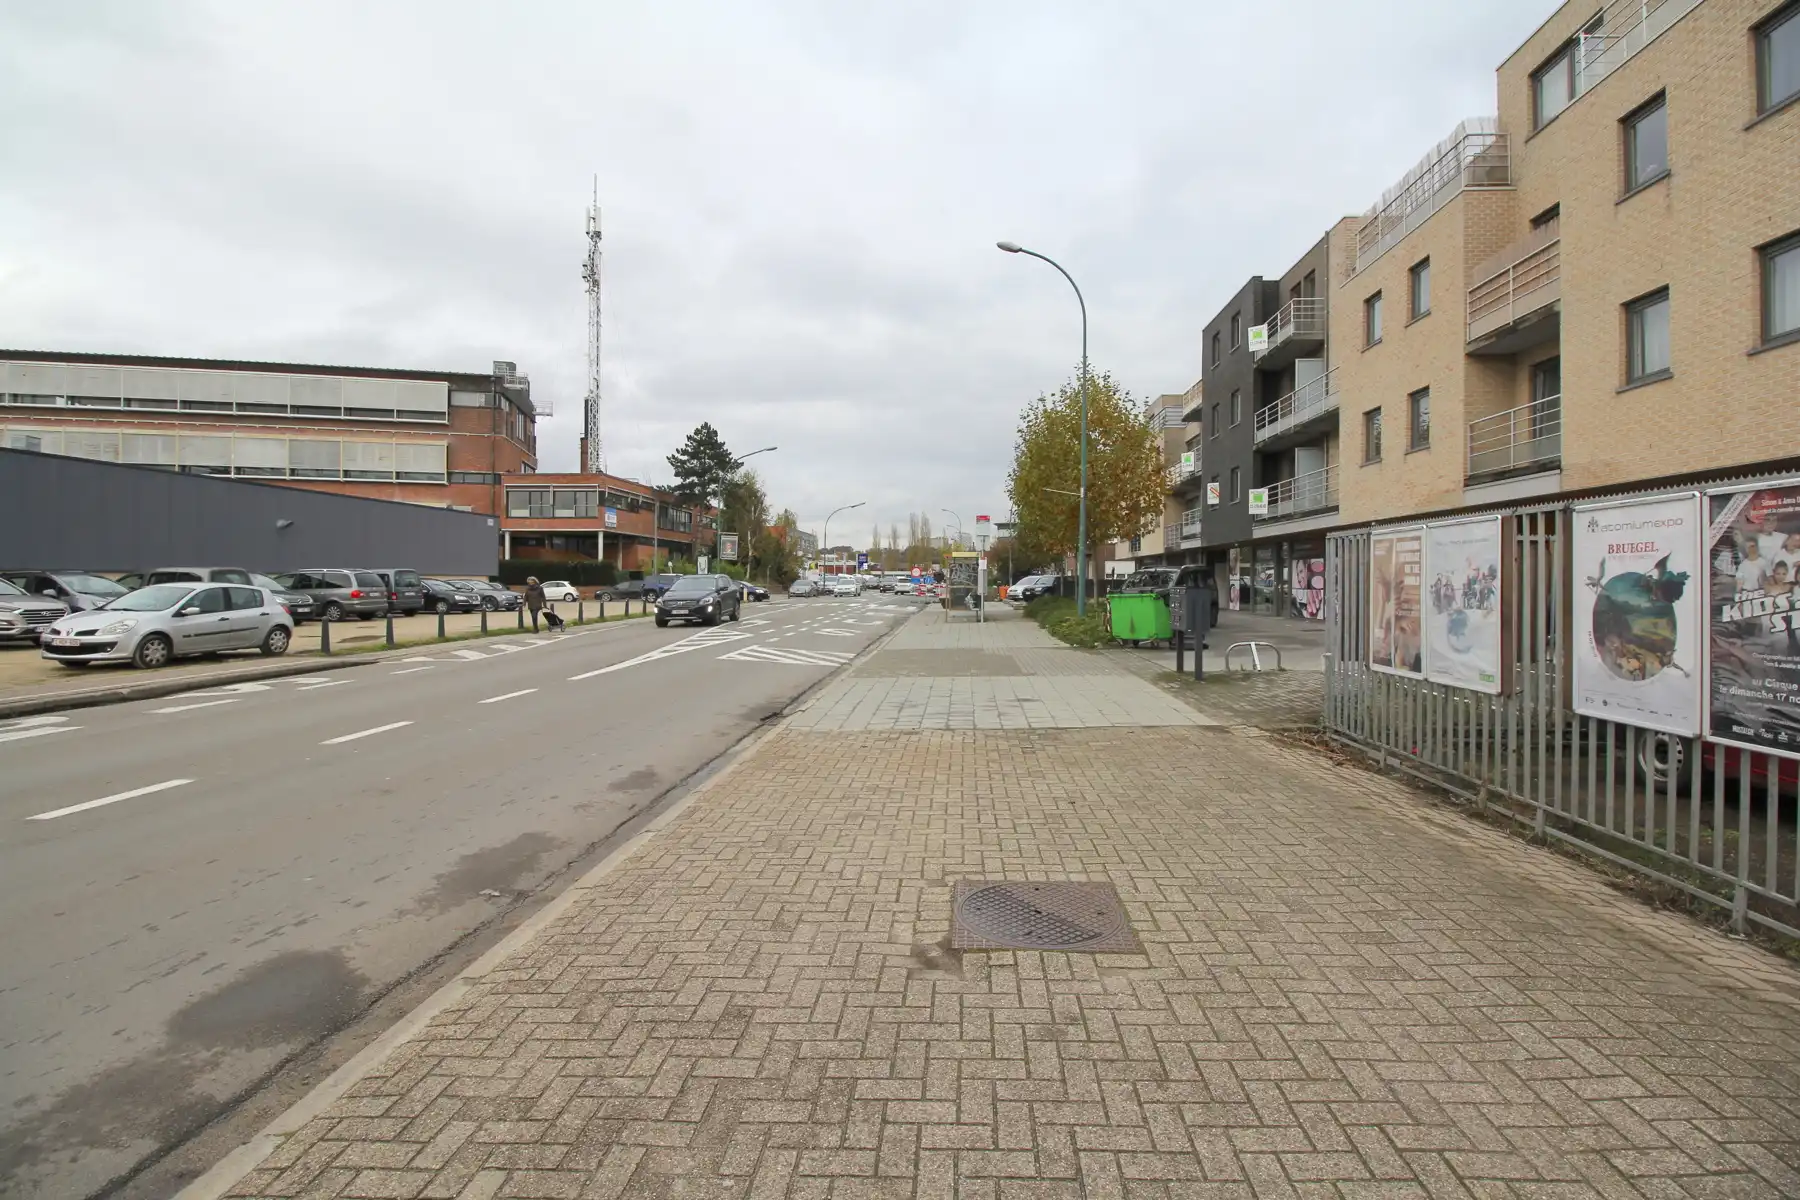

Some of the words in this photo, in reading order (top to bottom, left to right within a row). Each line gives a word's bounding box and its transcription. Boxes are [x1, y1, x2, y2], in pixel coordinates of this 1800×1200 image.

[1601, 517, 1683, 532] atomiumexpo
[1734, 589, 1765, 602] the
[1722, 593, 1792, 622] KIDS
[1765, 678, 1799, 691] Cirque
[1719, 685, 1728, 693] le
[1729, 686, 1774, 699] dimanche
[1776, 693, 1787, 702] 17
